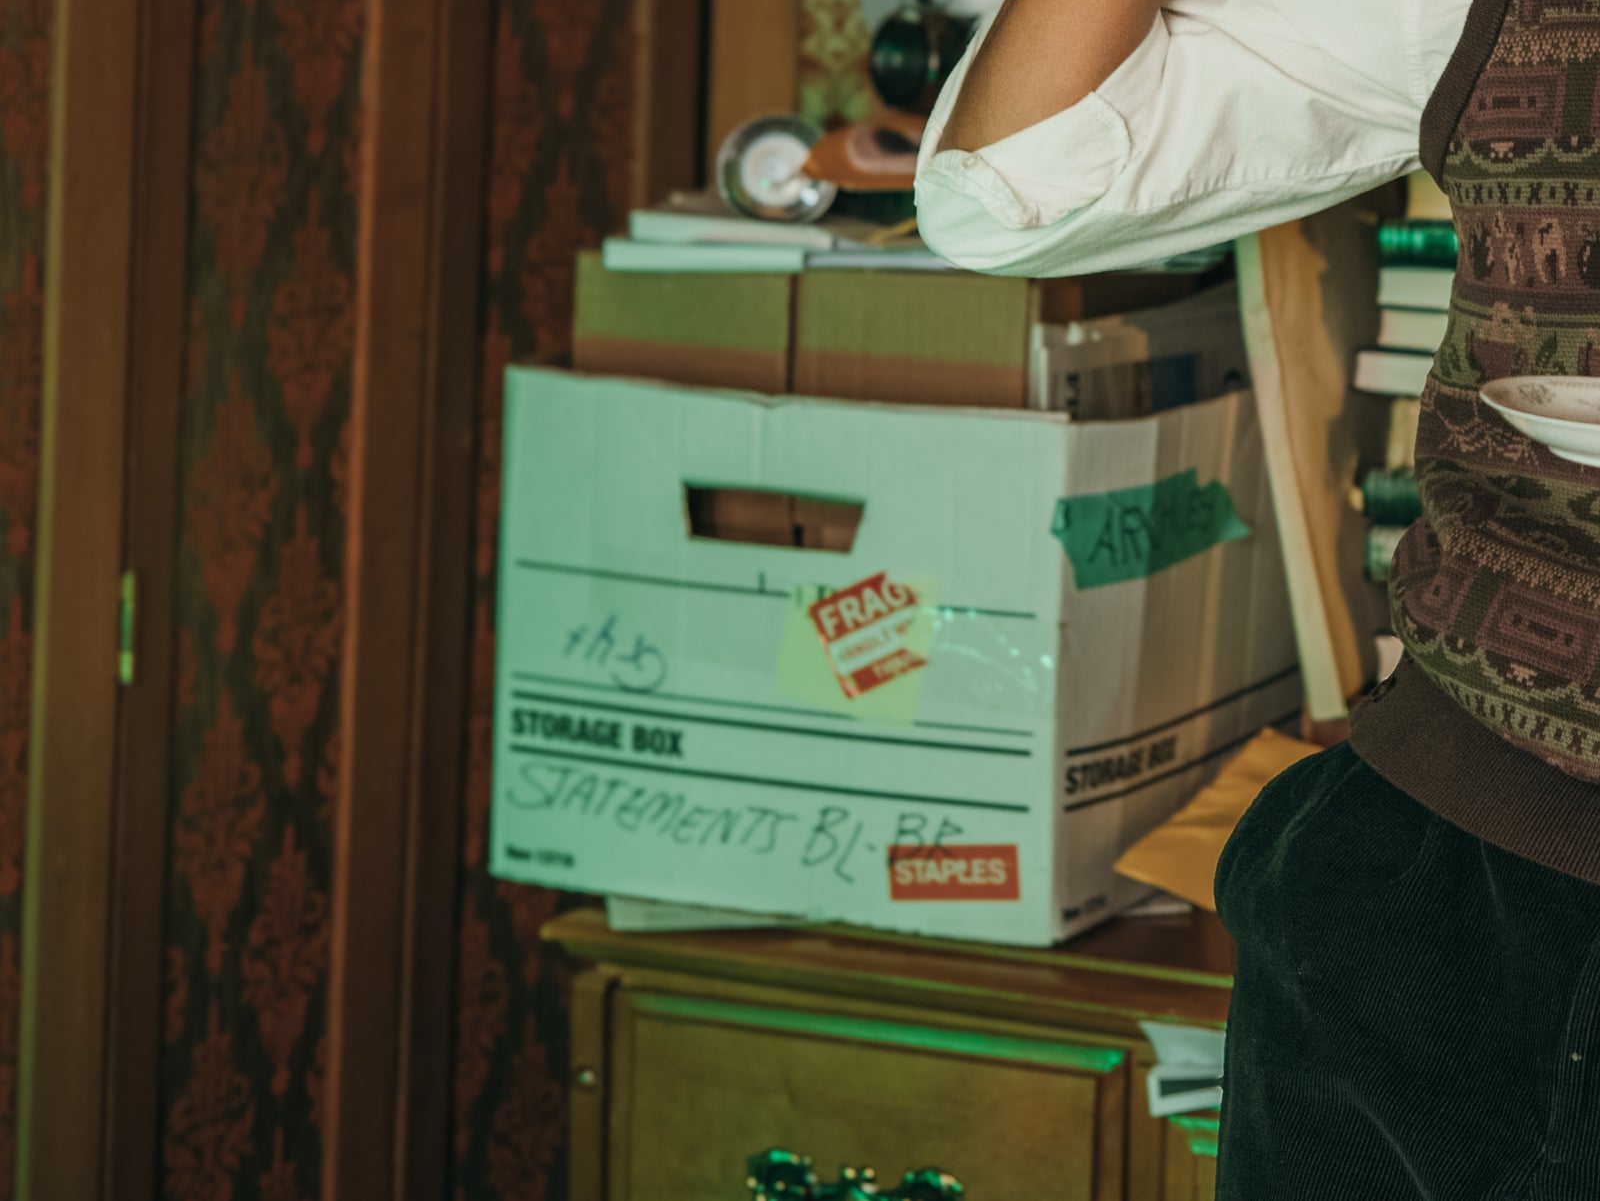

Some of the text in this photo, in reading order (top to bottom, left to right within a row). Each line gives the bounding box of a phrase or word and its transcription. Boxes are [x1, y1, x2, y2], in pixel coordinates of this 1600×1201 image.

[510, 707, 684, 758] STORAGE BOX
[1064, 734, 1178, 796] STORAGE BOX
[505, 758, 799, 855] STATEMENTS
[894, 858, 1007, 886] STAPLES
